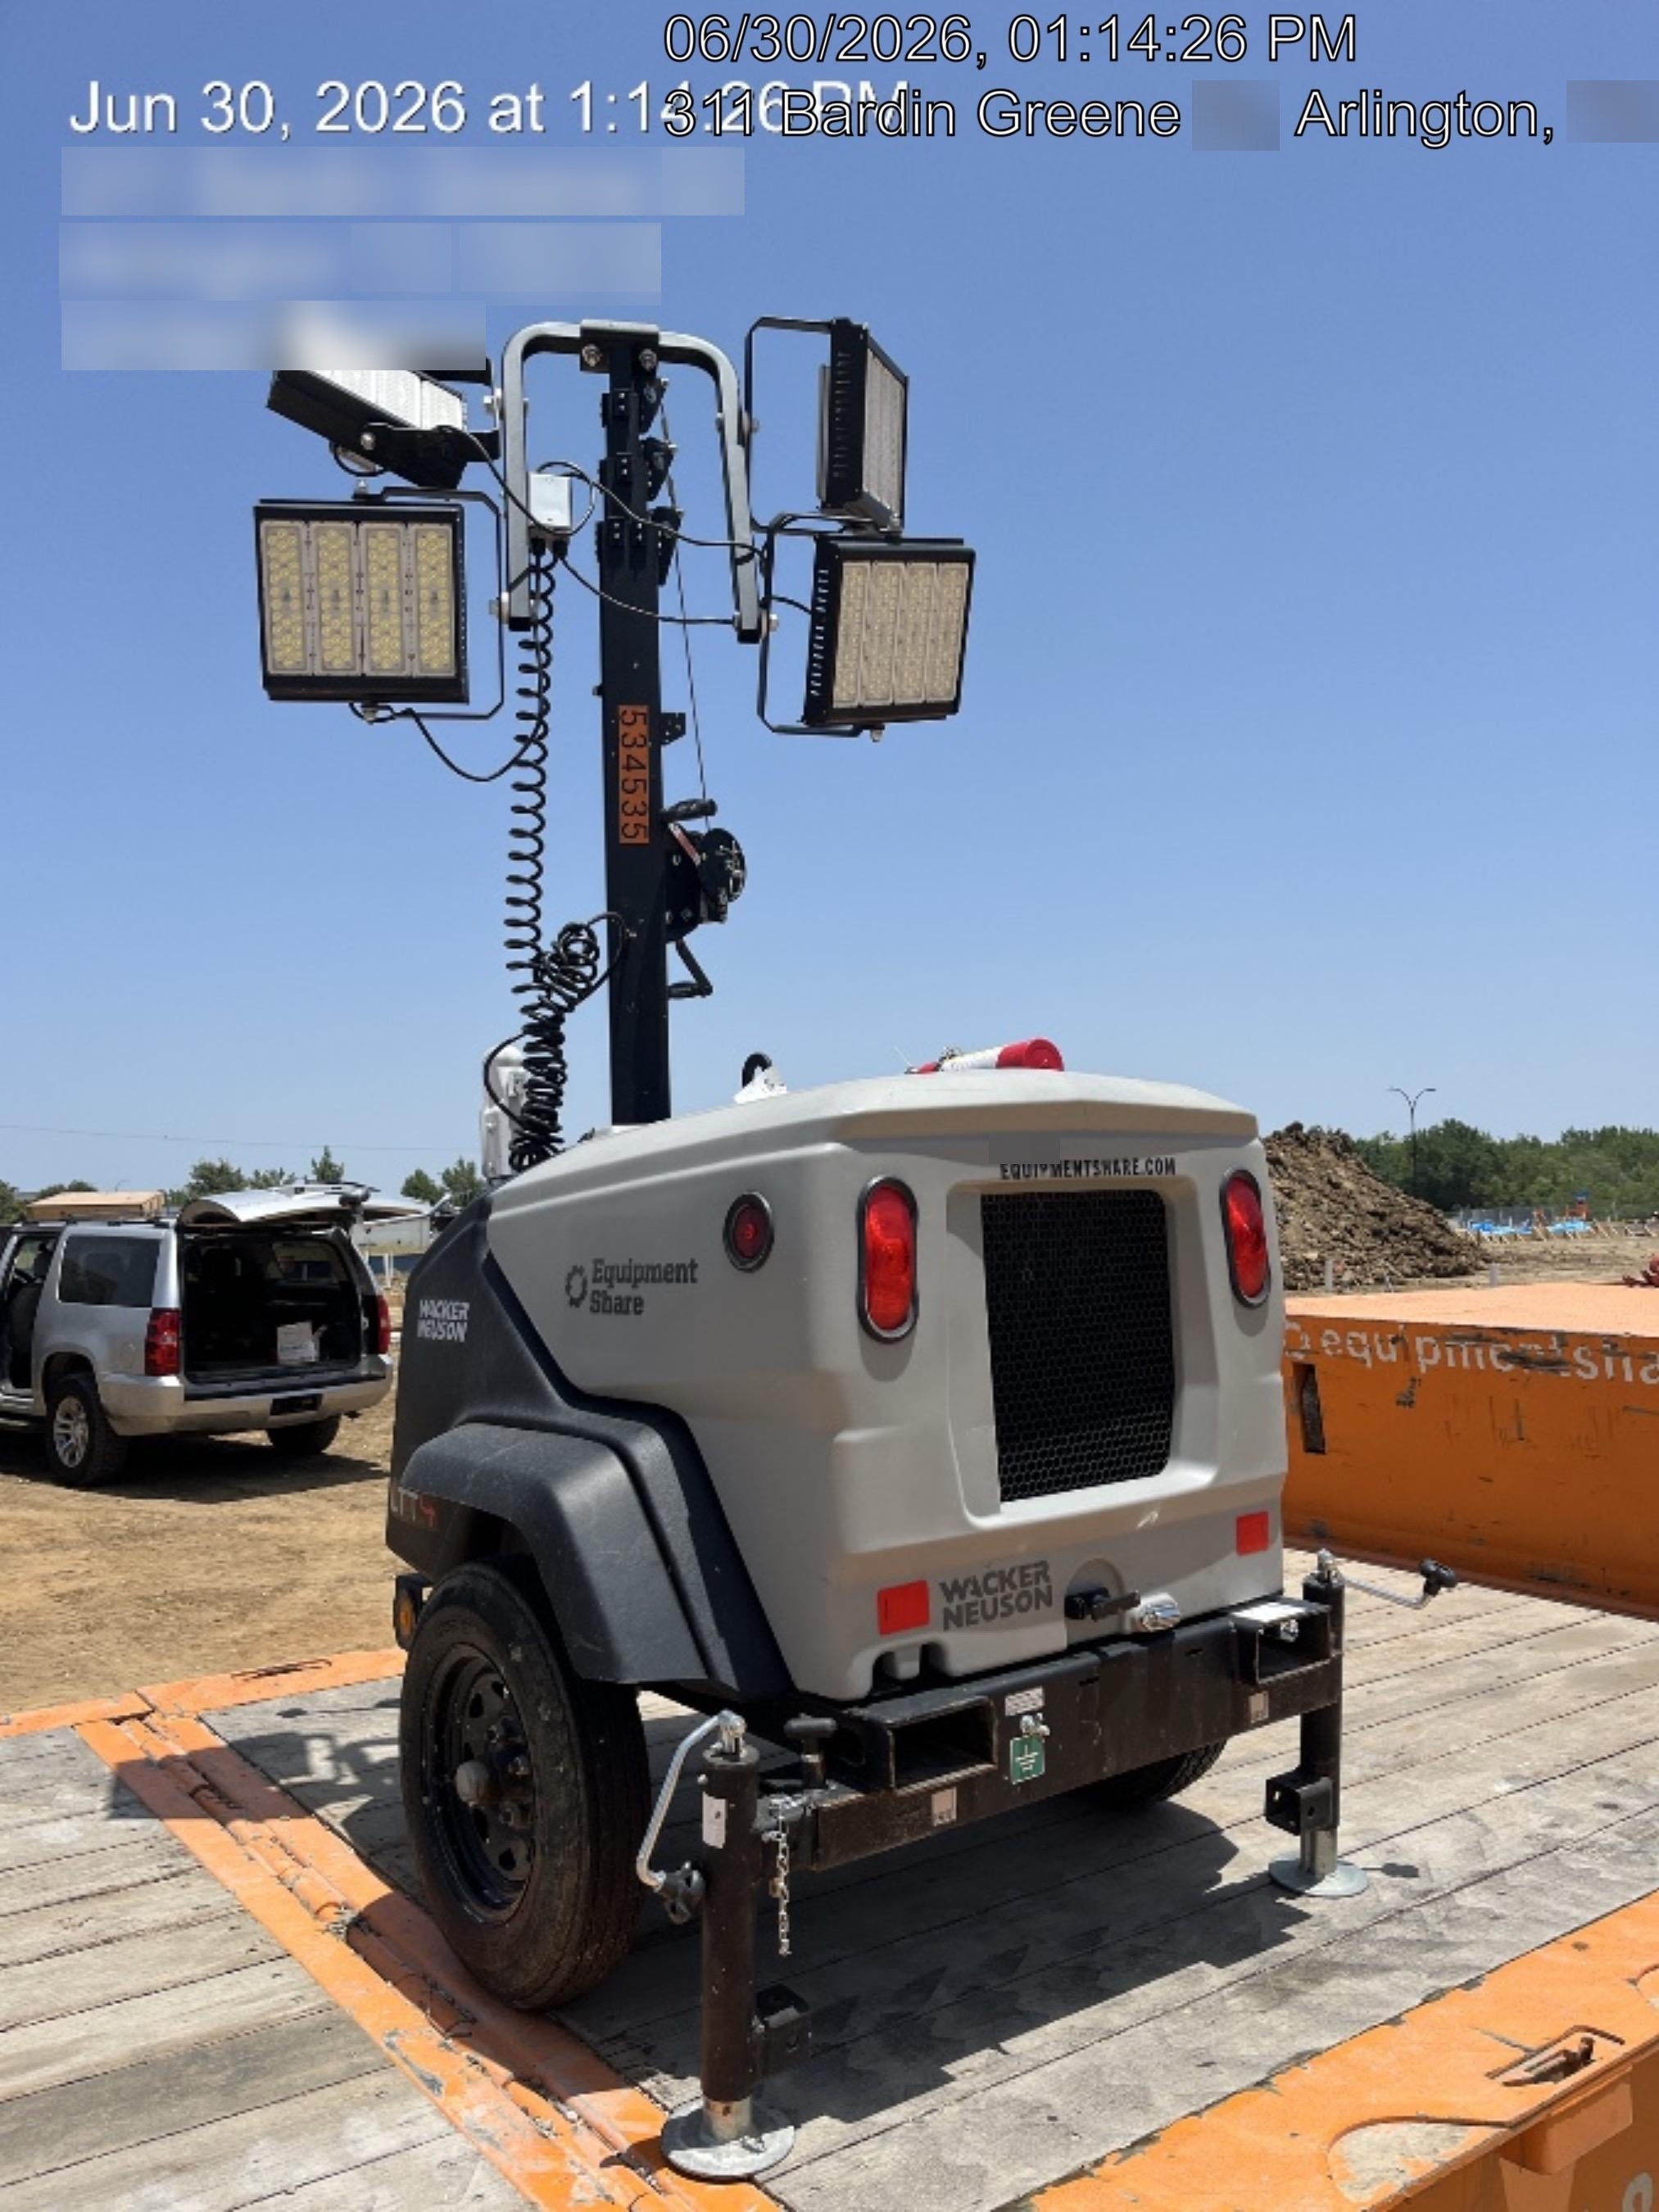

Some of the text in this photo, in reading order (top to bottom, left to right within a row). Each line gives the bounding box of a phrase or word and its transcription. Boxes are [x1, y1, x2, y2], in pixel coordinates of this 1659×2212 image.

[620, 709, 648, 839] 534535
[999, 1157, 1176, 1180] EQUIPMENTSHARE.COM
[592, 1258, 699, 1289] Equipment
[419, 1299, 470, 1320] WACKER
[589, 1290, 645, 1316] Share
[938, 1559, 1051, 1603] WACKER
[943, 1584, 1054, 1632] NEUSON
